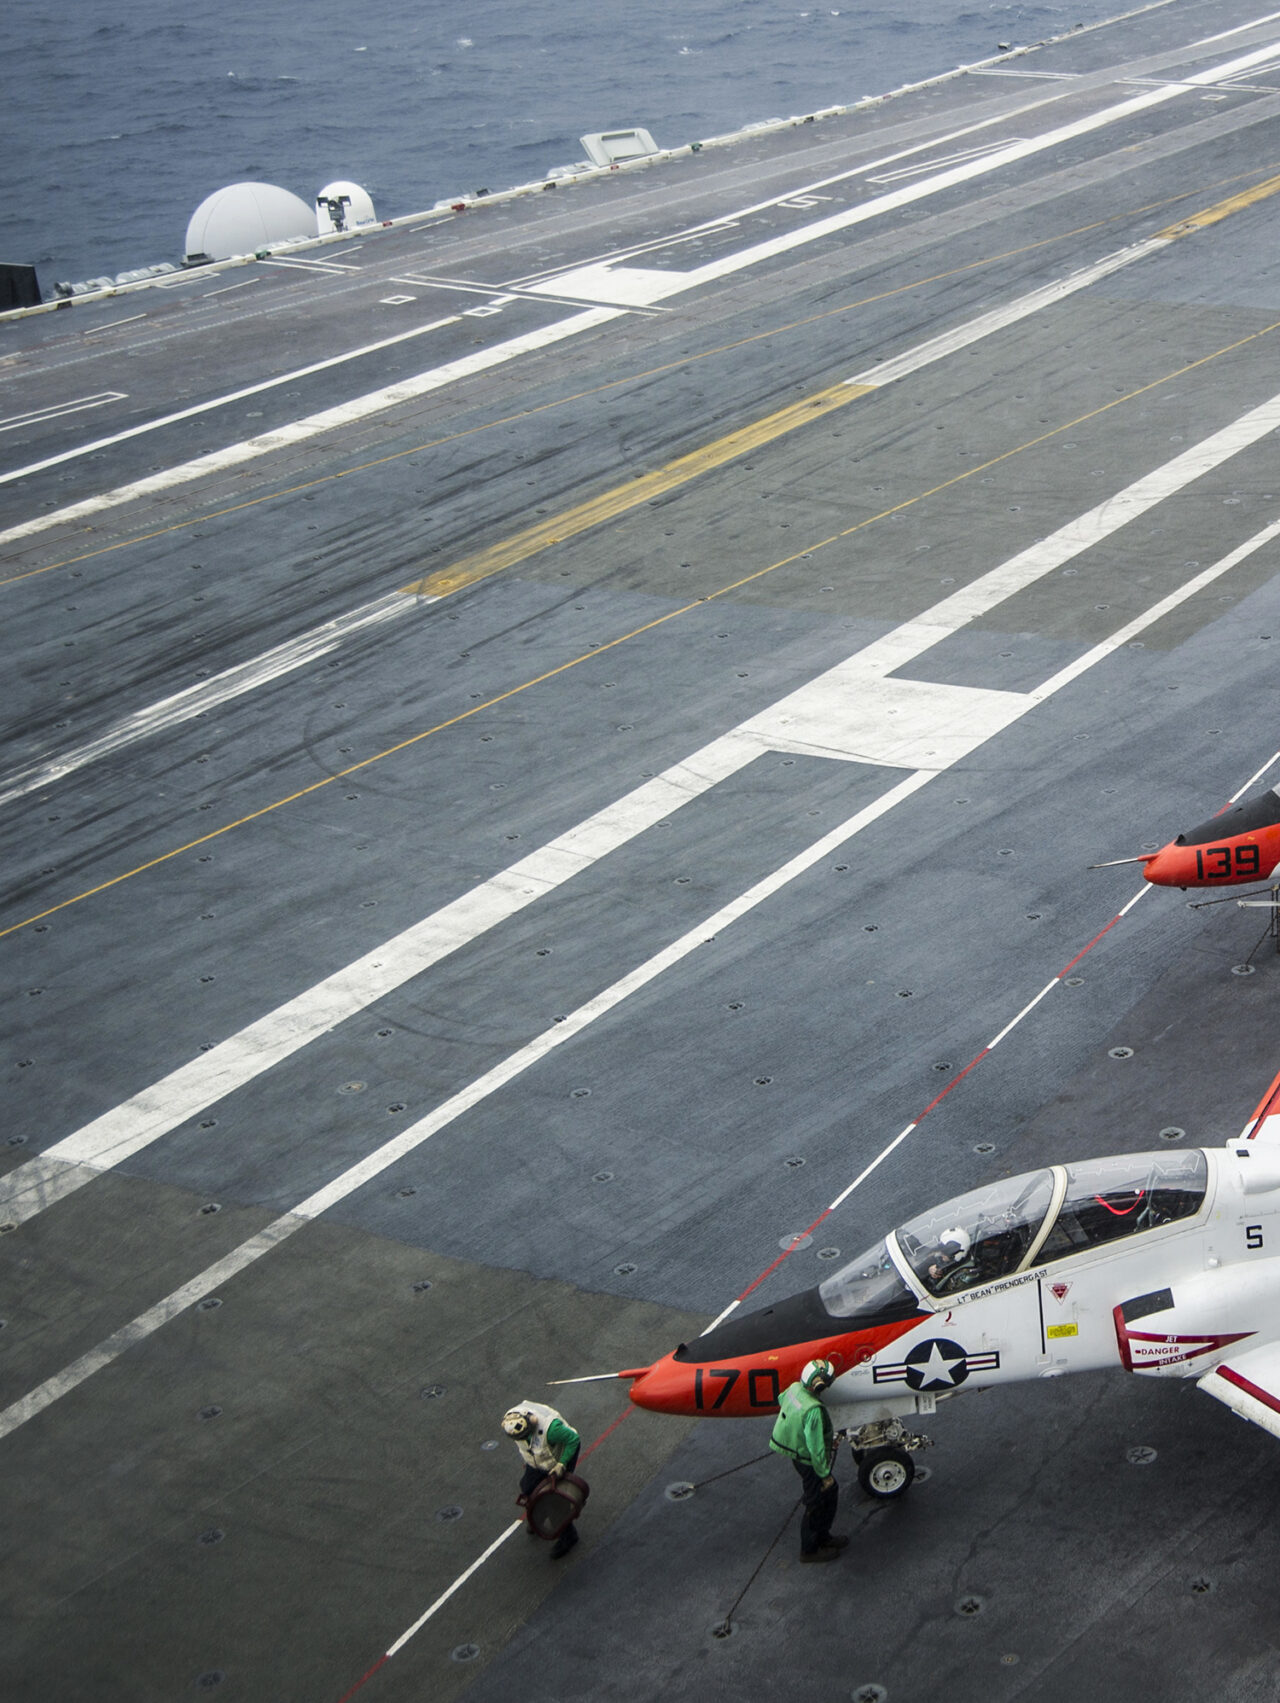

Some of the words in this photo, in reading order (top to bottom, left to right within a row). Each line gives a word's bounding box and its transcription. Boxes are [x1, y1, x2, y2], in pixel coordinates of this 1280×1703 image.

[1196, 844, 1259, 880] 139
[957, 1296, 966, 1305] LT
[1141, 1346, 1180, 1355] DANGER
[1158, 1354, 1187, 1365] INTAKE
[695, 1369, 780, 1409] 170
